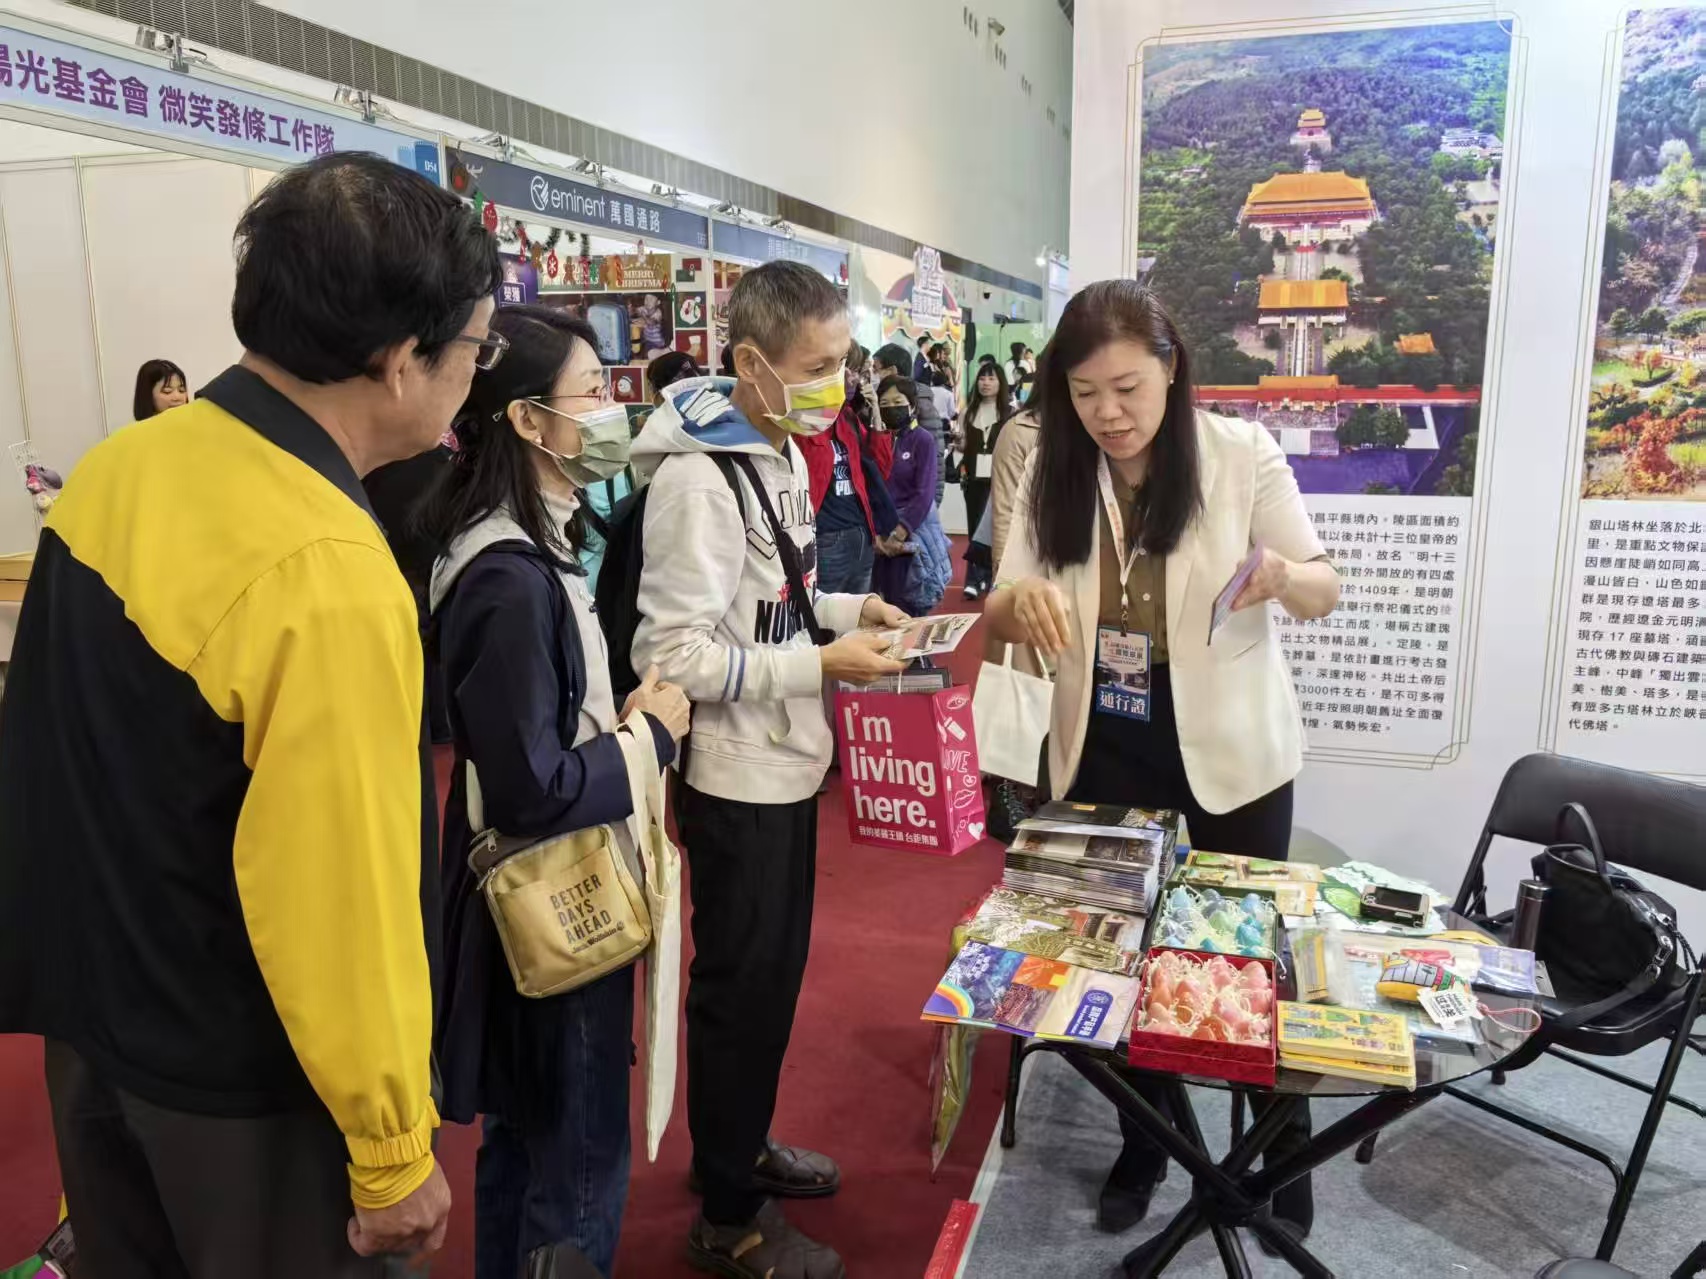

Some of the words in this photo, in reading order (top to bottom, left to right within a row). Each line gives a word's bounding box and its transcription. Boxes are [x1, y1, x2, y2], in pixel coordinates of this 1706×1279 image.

[158, 84, 335, 156] 微笑發條工作隊
[550, 186, 606, 220] eminent
[616, 279, 665, 288] CHRISTMA
[623, 270, 655, 279] MERRY
[1589, 519, 1706, 534] 銀山塔林坐落於北
[1585, 556, 1706, 572] 因懸崖陡峭如同高
[1610, 631, 1625, 641] 17
[843, 702, 893, 743] I'm
[849, 746, 937, 797] living
[853, 785, 937, 829] here.
[550, 873, 602, 910] BETTER
[557, 899, 594, 928] DAYS
[565, 909, 612, 945] AHEAD
